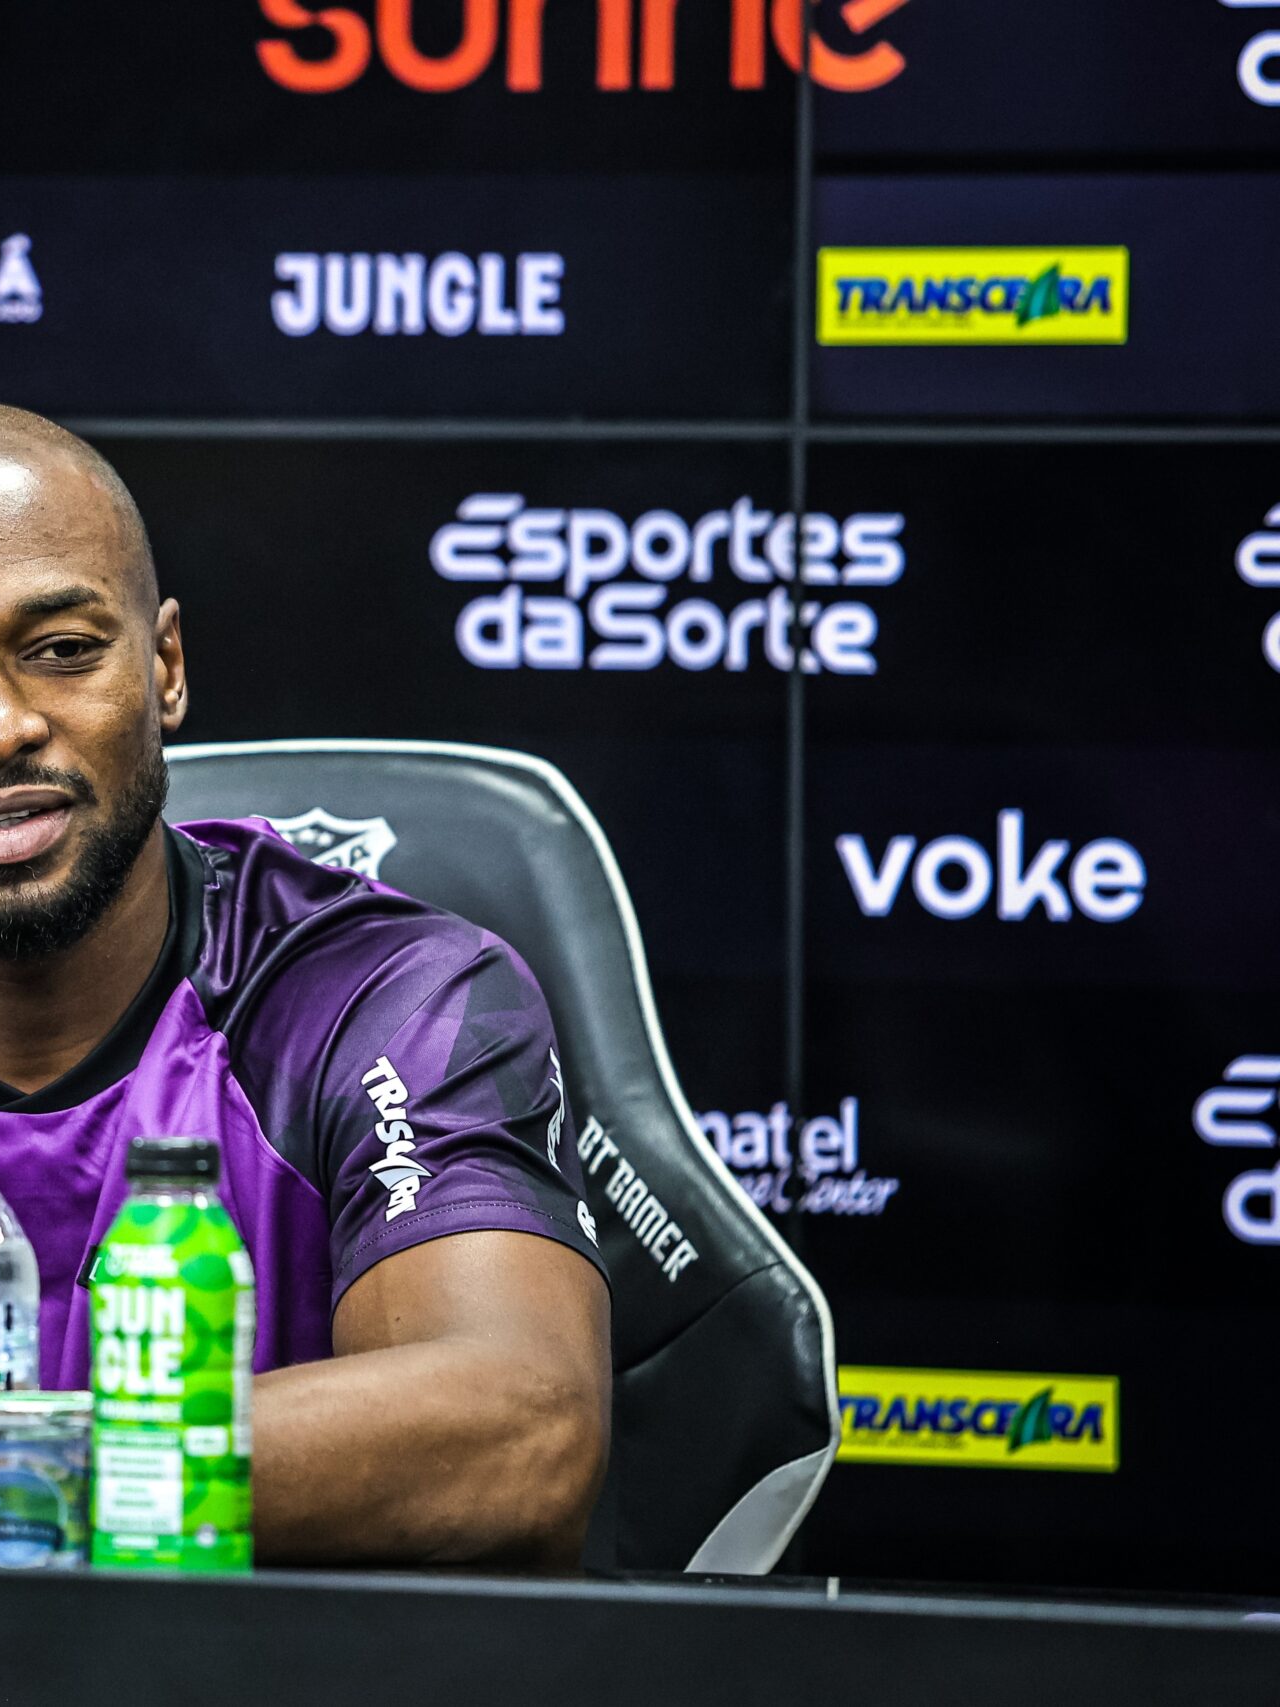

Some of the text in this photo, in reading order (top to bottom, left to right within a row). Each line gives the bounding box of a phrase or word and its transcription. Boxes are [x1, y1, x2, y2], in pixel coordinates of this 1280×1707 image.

[271, 251, 565, 337] JUNGLE
[835, 808, 1147, 923] voke
[605, 1158, 699, 1283] GAMER
